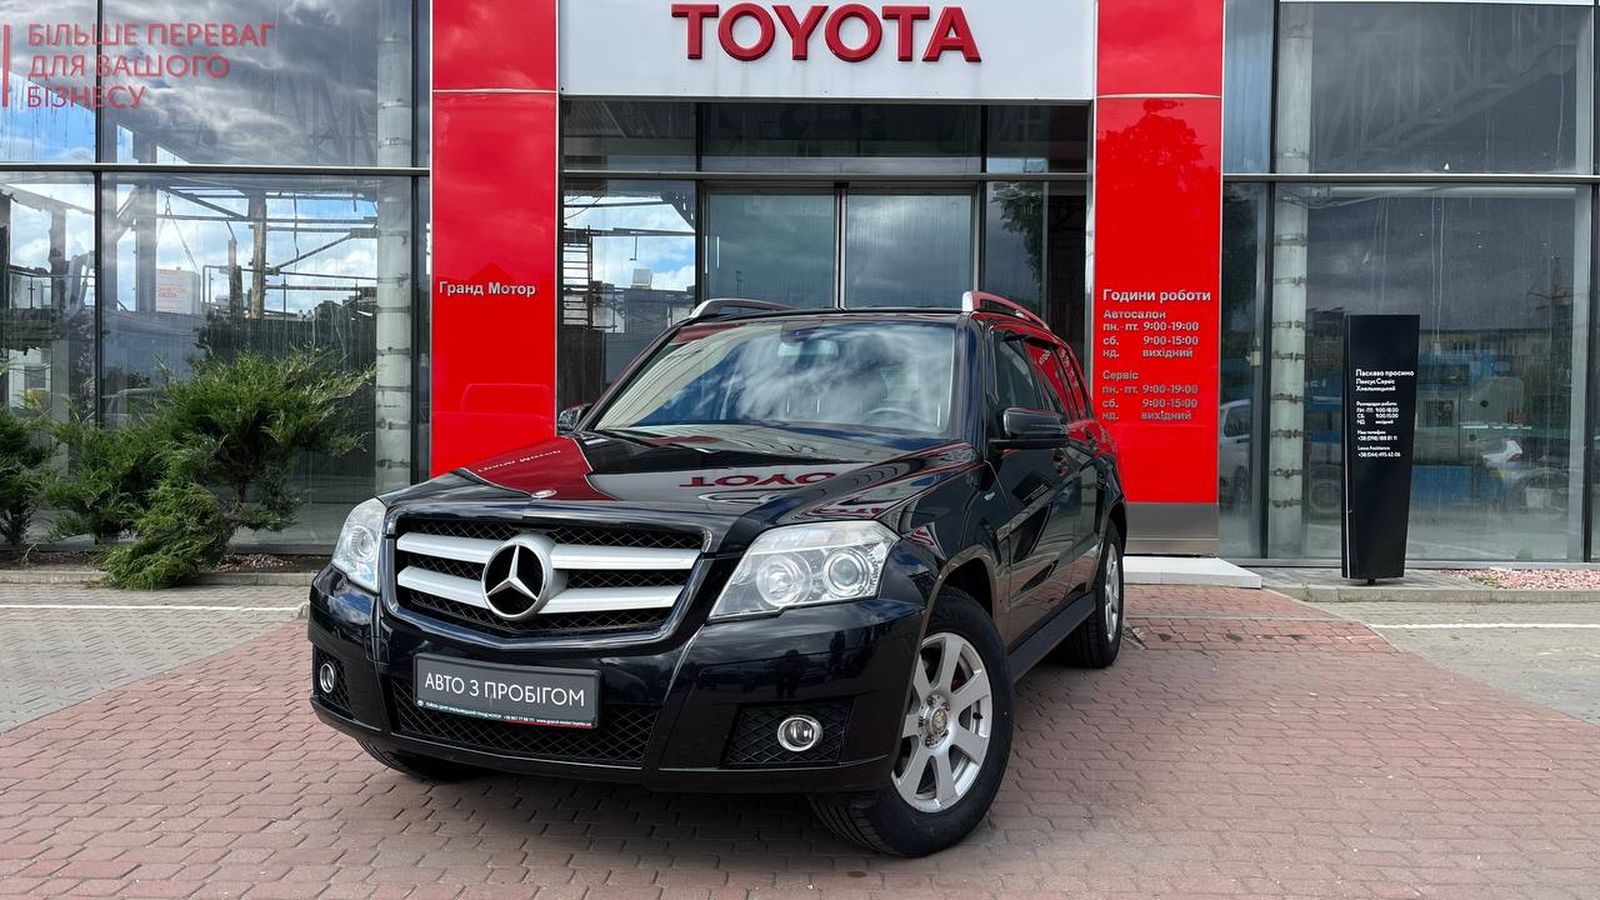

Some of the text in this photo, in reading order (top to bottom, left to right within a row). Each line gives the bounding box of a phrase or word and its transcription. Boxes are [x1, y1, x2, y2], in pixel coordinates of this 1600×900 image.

[28, 23, 275, 47] БІЛЬШЕ ПЕРЕВАГ
[671, 3, 982, 62] TOYOTA
[28, 54, 230, 80] ДЛЯ ВАШОГО
[27, 85, 146, 109] БІЗНЕСУ
[439, 281, 536, 298] Гранд Мотор
[1103, 289, 1211, 304] Години роботи
[1103, 310, 1166, 319] Автосалон
[1103, 336, 1119, 345] сб.
[1103, 348, 1193, 358] нд. вихідний
[1103, 370, 1139, 381] Сервіс
[1102, 399, 1119, 408] сб.
[1102, 410, 1191, 421] нд. вихідний
[425, 672, 465, 694] АВТО
[484, 681, 585, 707] ПРОБІГОМ
